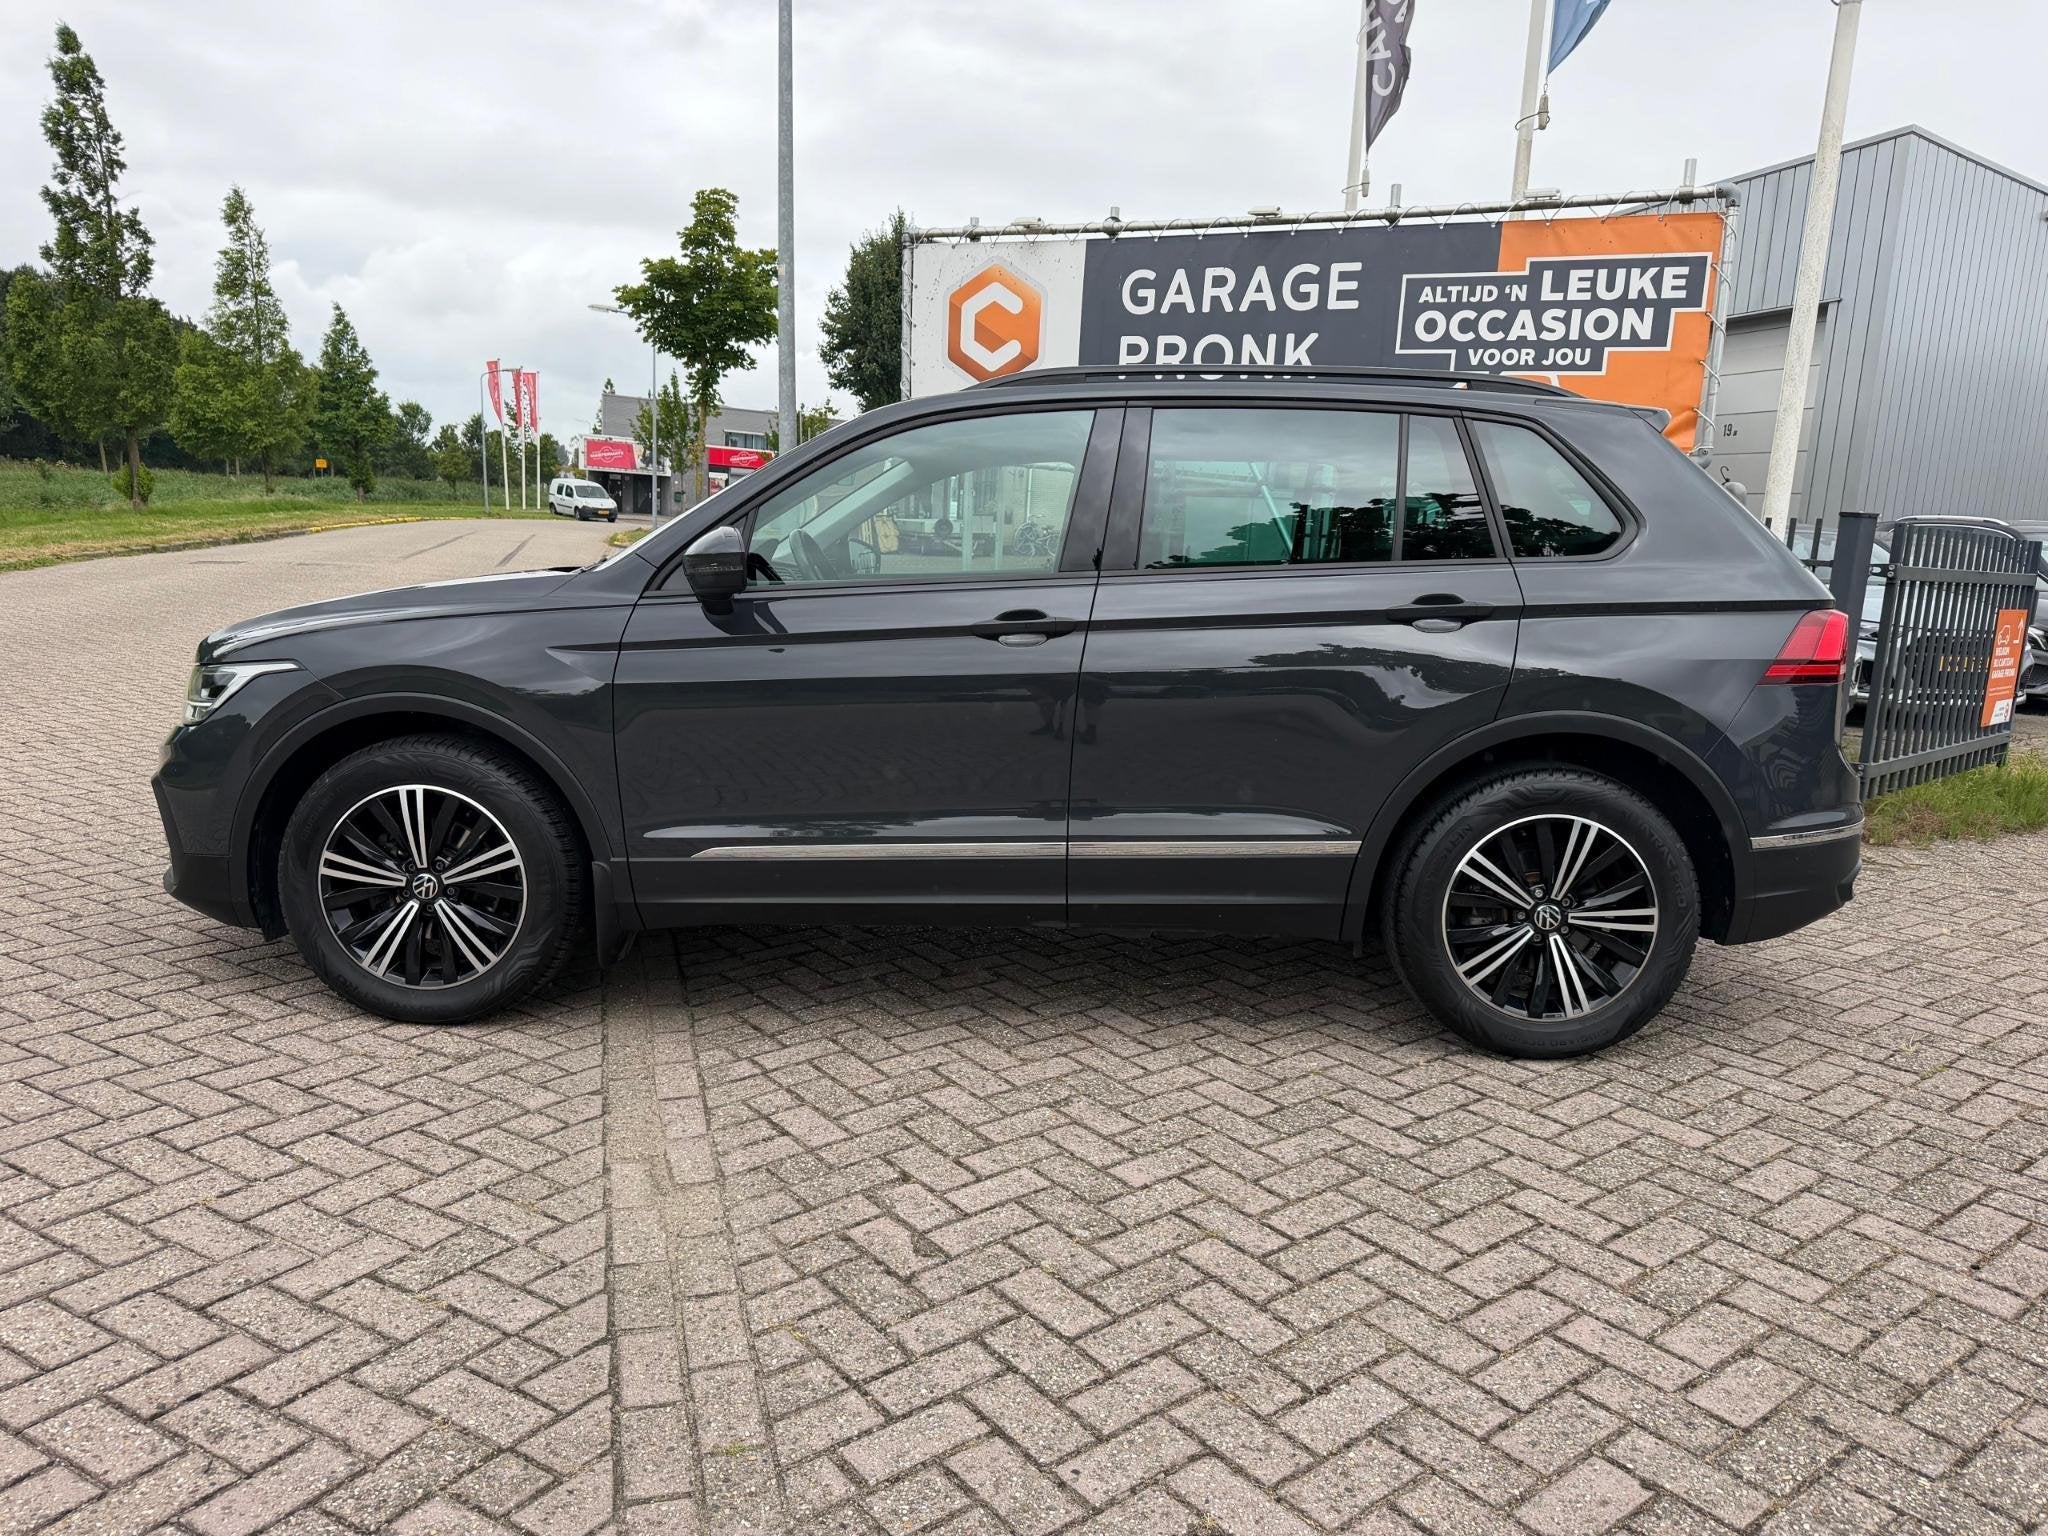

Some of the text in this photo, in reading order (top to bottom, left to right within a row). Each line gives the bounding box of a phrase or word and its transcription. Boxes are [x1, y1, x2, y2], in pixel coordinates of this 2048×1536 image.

[1121, 261, 1363, 315] GARAGE
[1418, 284, 1499, 304] ALTIJD
[1540, 265, 1691, 301] LEUKE
[1414, 306, 1655, 343] OCCASION
[1118, 332, 1320, 380] PRONK
[1467, 347, 1592, 367] VOOR JOU
